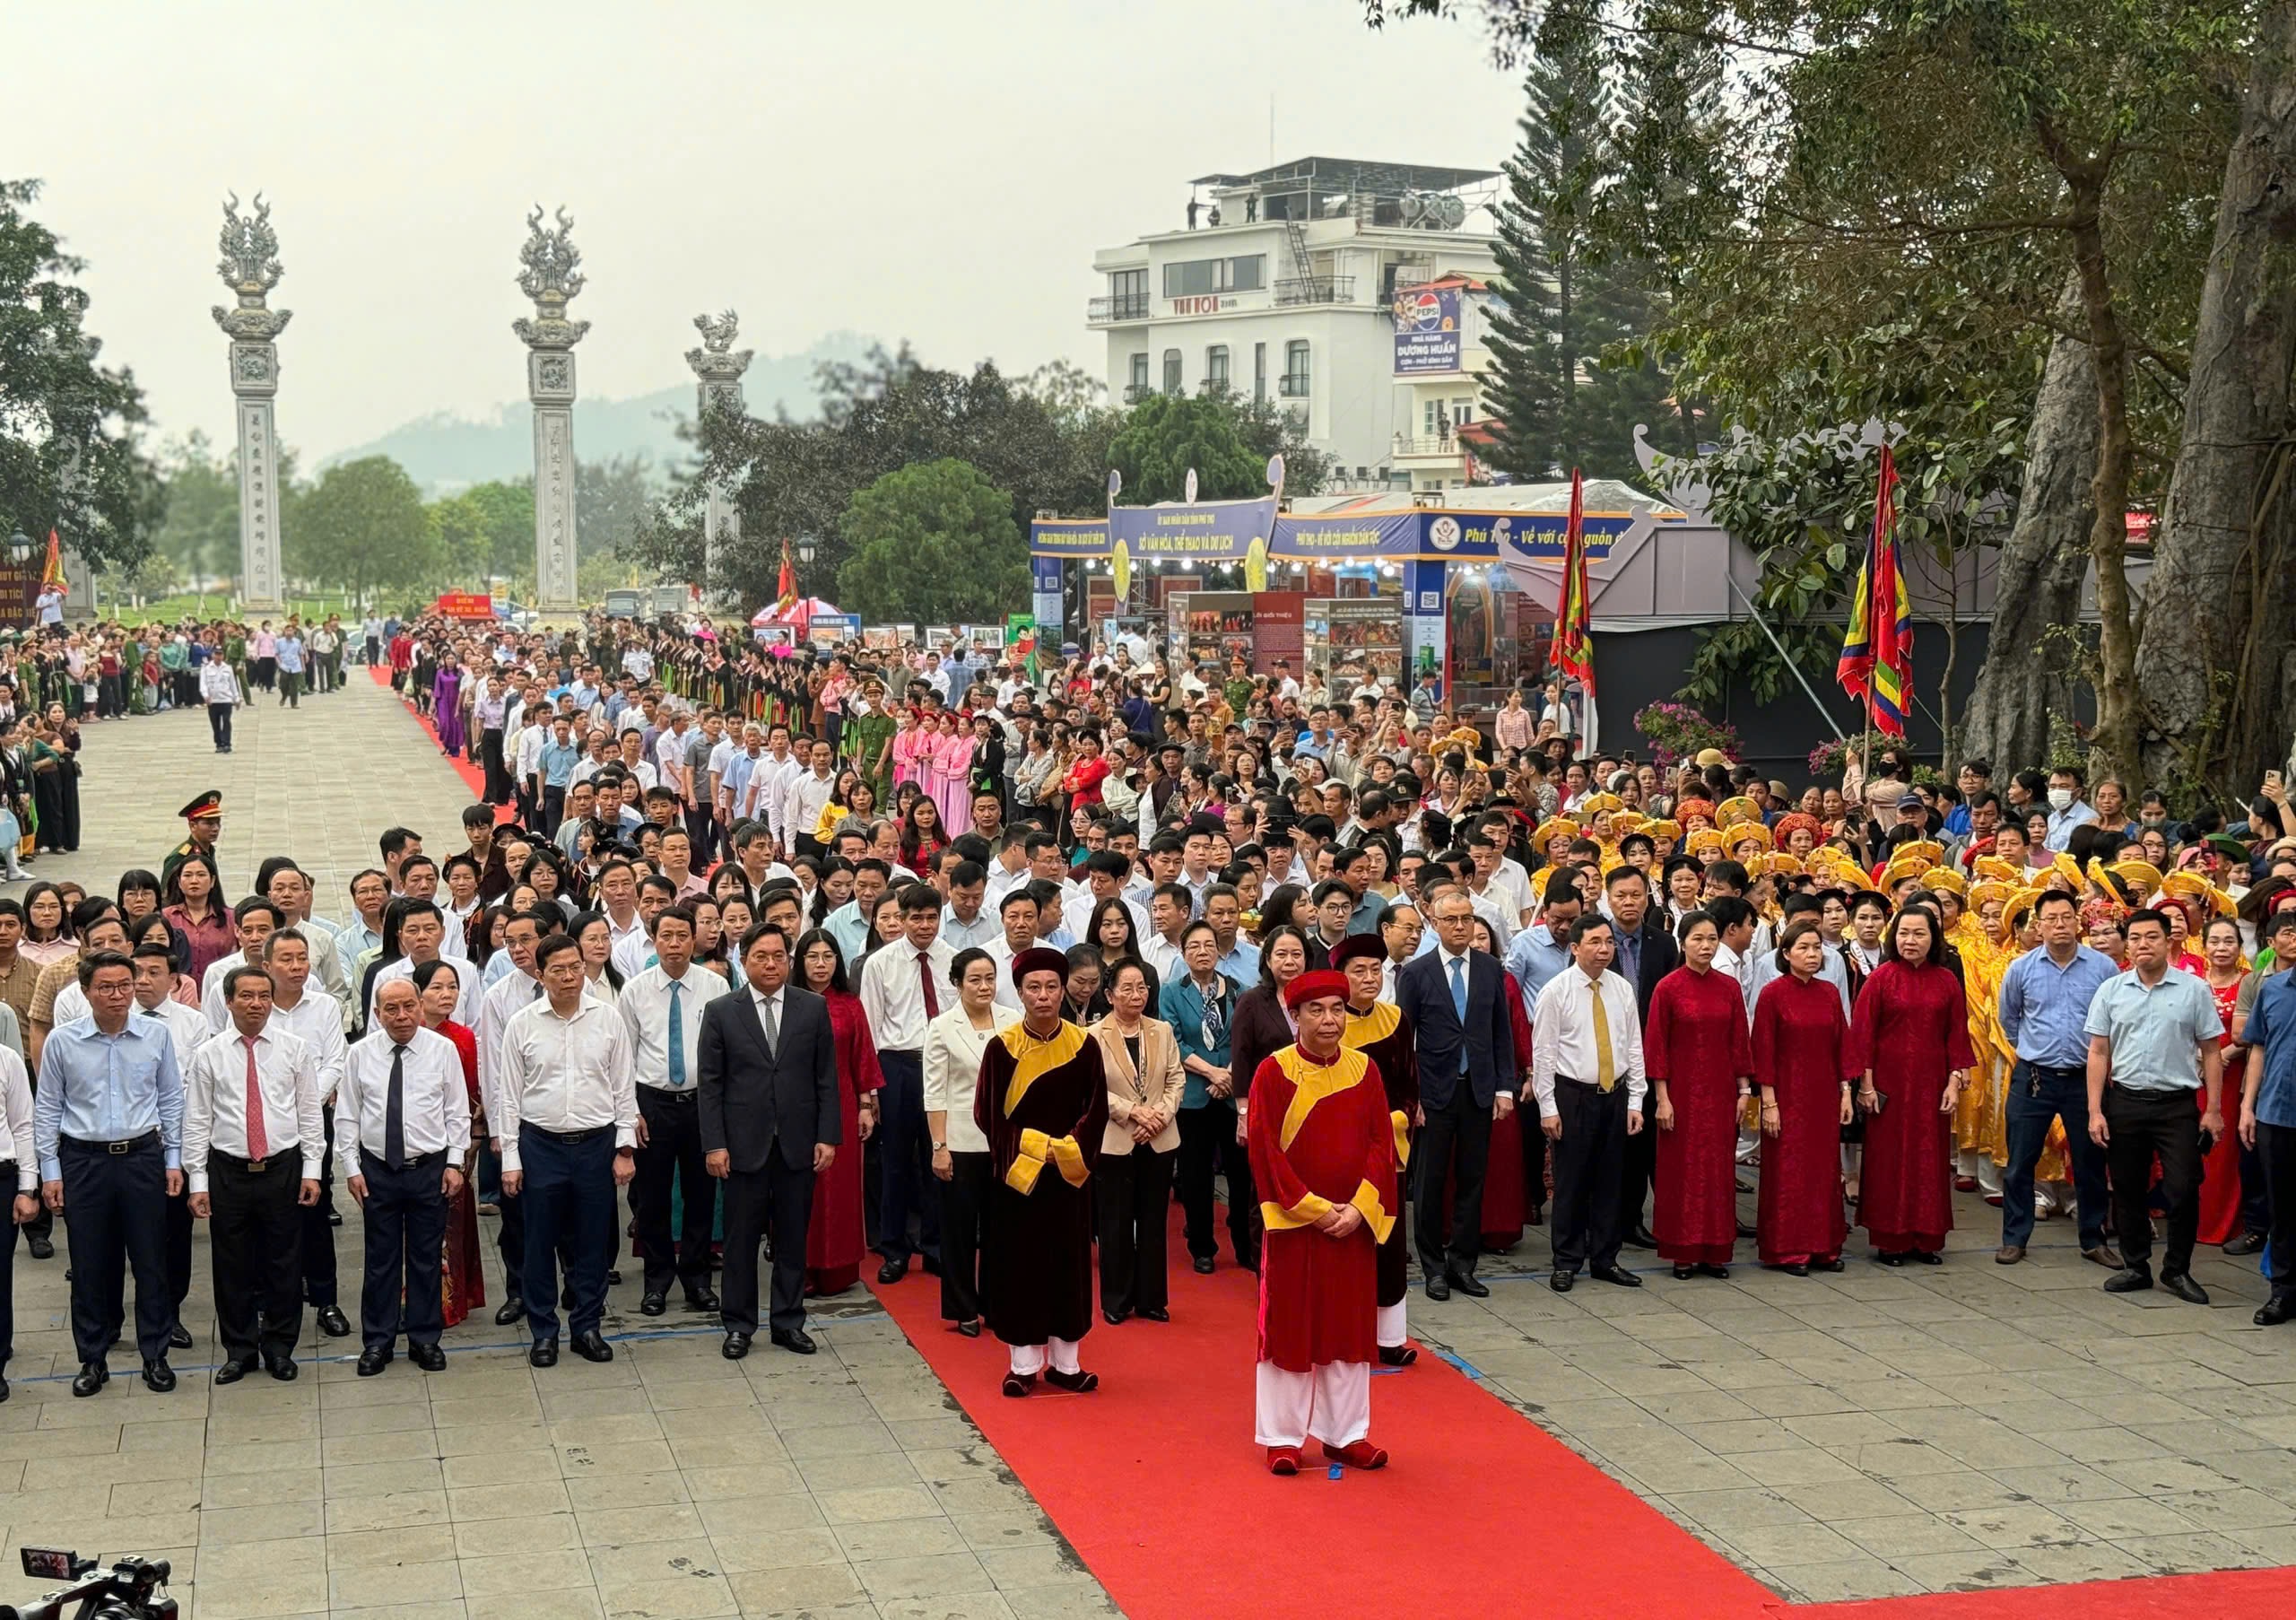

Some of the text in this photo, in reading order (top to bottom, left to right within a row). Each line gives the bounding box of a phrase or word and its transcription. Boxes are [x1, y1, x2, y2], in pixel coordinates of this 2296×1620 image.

[1416, 308, 1439, 316] PEPSI
[1465, 527, 1487, 543] Phú
[1521, 525, 1535, 544] Về
[1537, 528, 1556, 544] với
[1185, 536, 1201, 551] THAO
